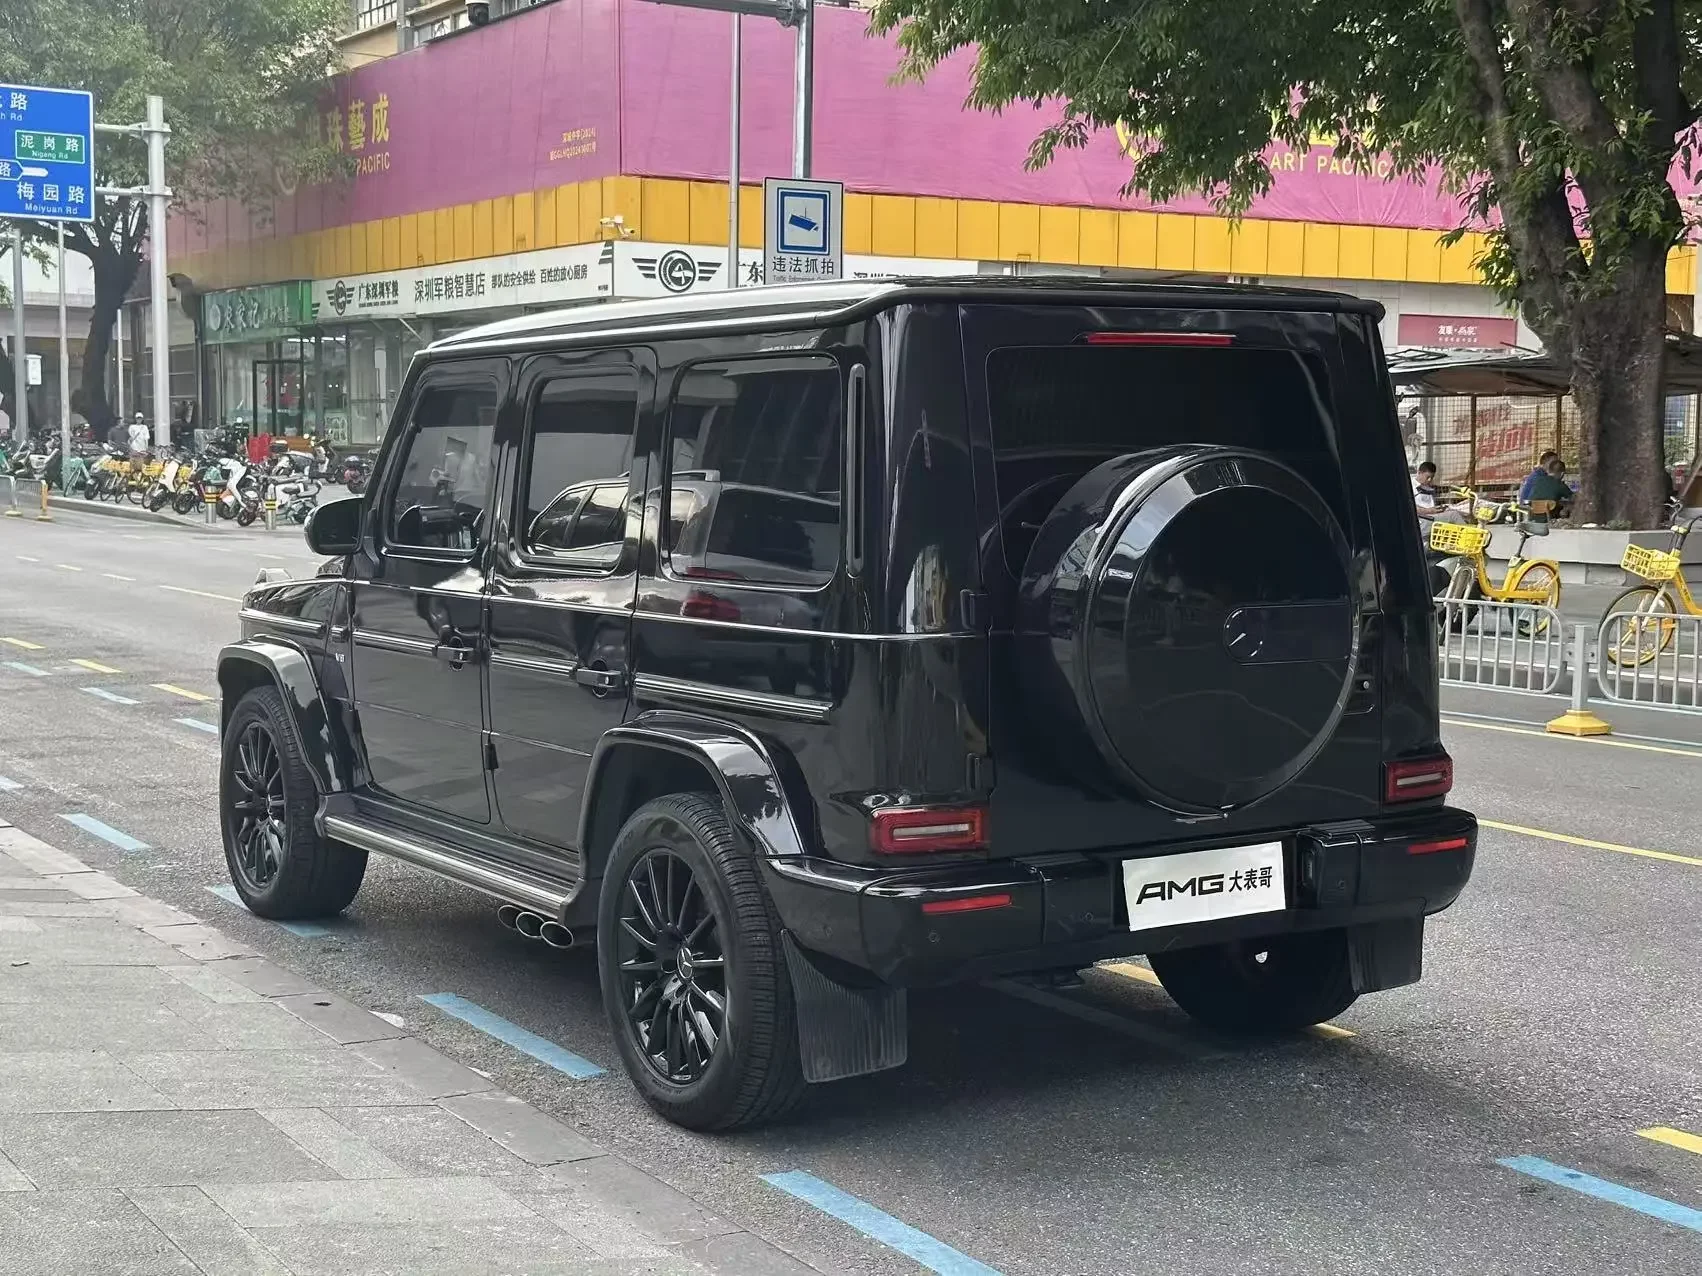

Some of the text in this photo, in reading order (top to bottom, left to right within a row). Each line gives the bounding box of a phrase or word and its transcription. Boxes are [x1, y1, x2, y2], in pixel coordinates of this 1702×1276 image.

[0, 92, 28, 111] 路
[10, 112, 23, 121] Rd
[20, 134, 79, 152] 泥岗路
[58, 152, 69, 160] Rd
[356, 151, 390, 176] PACIFIC
[1269, 151, 1390, 179] ART PACIIC
[16, 181, 85, 204] 梅园路
[25, 203, 78, 215] Meiyuan Rd
[772, 255, 835, 275] 违法抓拍
[414, 272, 486, 304] 深圳军粮智慧店
[540, 264, 588, 283] 百姓的放心厨房
[1136, 866, 1273, 905] AMG 大表哥
